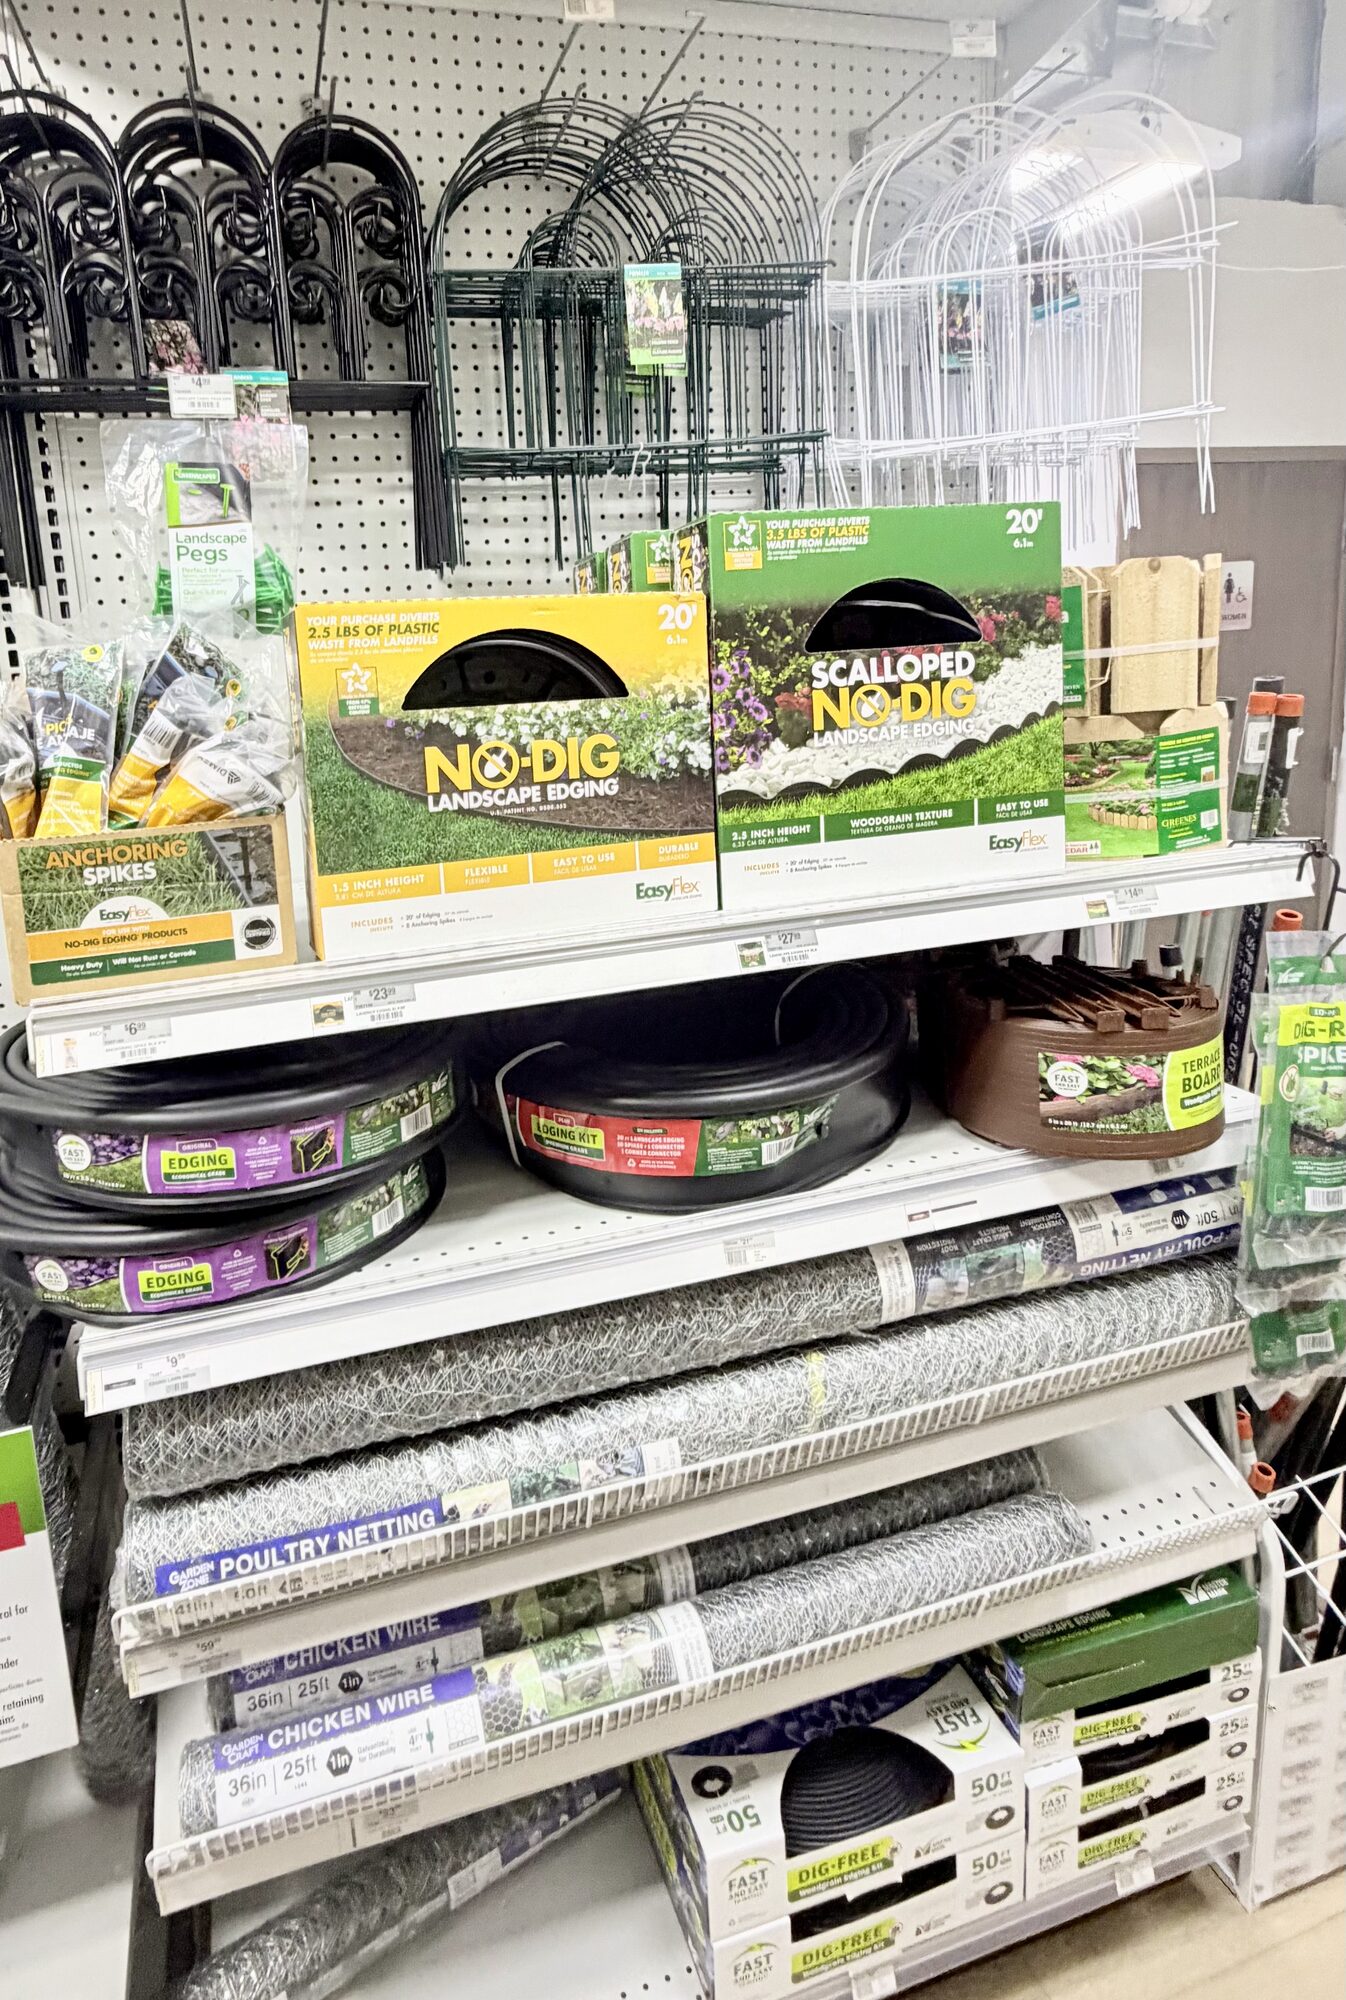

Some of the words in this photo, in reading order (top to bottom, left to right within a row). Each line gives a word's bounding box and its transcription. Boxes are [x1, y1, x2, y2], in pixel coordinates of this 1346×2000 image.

[766, 520, 790, 529] YOUR
[792, 518, 836, 528] PURCHASE
[838, 516, 870, 525] DIVERTS
[1006, 508, 1043, 534] 20'
[175, 532, 247, 546] Landscape
[767, 529, 784, 540] 3.5
[788, 528, 807, 539] LBS
[810, 527, 825, 537] OF
[829, 525, 869, 537] PLASTIC
[766, 539, 796, 549] WASTE
[799, 538, 822, 548] FROM
[825, 536, 868, 546] LANDFILLS
[1013, 537, 1034, 548] 6.1m
[177, 546, 228, 564] Pegs
[306, 616, 337, 626] YOUR
[340, 614, 396, 625] PURCHASE
[400, 612, 440, 622] DIVERTS
[657, 603, 698, 630] 20'
[308, 627, 330, 638] 2.5
[336, 626, 360, 638] LBS
[365, 625, 384, 636] OF
[388, 622, 440, 635] PLASTIC
[308, 640, 345, 650] WASTE
[348, 638, 380, 648] FROM
[384, 635, 438, 646] LANDFILLS
[666, 634, 688, 645] 6.1m
[811, 650, 976, 689] SCALLOPED
[812, 677, 977, 731] NO-DIG
[813, 724, 912, 748] LANDSCAPE
[913, 718, 976, 738] EDGING
[424, 733, 620, 794] NO-DIG
[427, 785, 542, 813] LANDSCAPE
[546, 778, 619, 802] EDGING
[996, 802, 1018, 812] EASY
[1020, 801, 1031, 809] TO
[1033, 799, 1049, 808] USE
[850, 814, 912, 828] WOODGRAIN
[914, 809, 953, 821] TEXTURE
[732, 831, 747, 841] 2.5
[750, 828, 774, 840] INCH
[777, 824, 811, 836] HEIGHT
[768, 836, 788, 844] ALTURA
[988, 829, 1047, 853] EasyFlex
[46, 840, 188, 869] ANCHORING
[658, 842, 699, 854] DURABLE
[554, 856, 577, 868] EASY
[581, 855, 594, 864] TO
[598, 852, 616, 862] USE
[744, 862, 780, 872] INCLUDES
[82, 862, 158, 886] SPIKES
[464, 864, 508, 878] FLEXIBLE
[332, 883, 349, 894] 1.5
[354, 880, 382, 891] INCH
[385, 874, 425, 887] HEIGHT
[378, 888, 401, 896] ALTURA
[635, 876, 699, 902] EasyFlex
[100, 904, 151, 922] EasyFlex
[351, 916, 394, 928] INCLUDES
[422, 912, 441, 920] Edging
[411, 919, 438, 928] Anchoring
[439, 918, 456, 926] Spikes
[64, 938, 100, 950] NO-DIG
[102, 934, 138, 946] EDGING
[142, 928, 188, 940] PRODUCTS
[112, 956, 126, 966] Will
[127, 954, 142, 964] Not
[142, 953, 158, 963] Rust
[168, 949, 197, 960] Corrode
[61, 963, 85, 974] Heavy
[86, 960, 104, 972] Duty
[1182, 1049, 1220, 1074] TERRACE
[1054, 1074, 1081, 1083] FAST
[578, 1131, 598, 1144] KIT
[663, 1136, 684, 1144] EDGING
[168, 1154, 228, 1170] EDGING
[1197, 1210, 1220, 1226] 50ft
[1152, 1232, 1224, 1258] POULTRY
[1080, 1253, 1152, 1276] NETTING
[146, 1270, 206, 1288] EDGING
[169, 1560, 214, 1586] GARDEN
[219, 1536, 331, 1579] POULTRY
[338, 1508, 436, 1548] NETTING
[180, 1574, 211, 1592] ZONE
[15, 1604, 28, 1616] for
[1016, 1617, 1074, 1644] LANDSCAPE
[283, 1628, 380, 1670] CHICKEN
[384, 1615, 440, 1642] WIRE
[245, 1666, 275, 1683] CRAFT
[1221, 1663, 1242, 1682] 25
[2, 1694, 44, 1712] retaining
[247, 1690, 283, 1712] 36in
[298, 1676, 330, 1698] 25ft
[926, 1702, 952, 1718] EASY
[222, 1734, 264, 1756] GARDEN
[268, 1708, 372, 1750] CHICKEN
[376, 1683, 436, 1716] WIRE
[936, 1708, 984, 1736] FAST
[1220, 1718, 1240, 1738] 25
[1032, 1724, 1060, 1741] FAST
[228, 1745, 260, 1766] CRAFT
[368, 1746, 396, 1763] Durability
[228, 1772, 267, 1798] 36in
[282, 1756, 318, 1782] 25ft
[329, 1752, 350, 1771] 1in
[971, 1773, 998, 1798] 50
[1041, 1794, 1067, 1811] FAST
[716, 1824, 728, 1836] FT
[726, 1804, 760, 1834] 50
[798, 1842, 881, 1884] DIG-FREE
[972, 1851, 998, 1876] 50
[1038, 1849, 1065, 1866] FAST
[728, 1868, 768, 1892] FAST
[728, 1890, 746, 1901] AND
[748, 1882, 768, 1894] EASY
[733, 1952, 774, 1976] FAST
